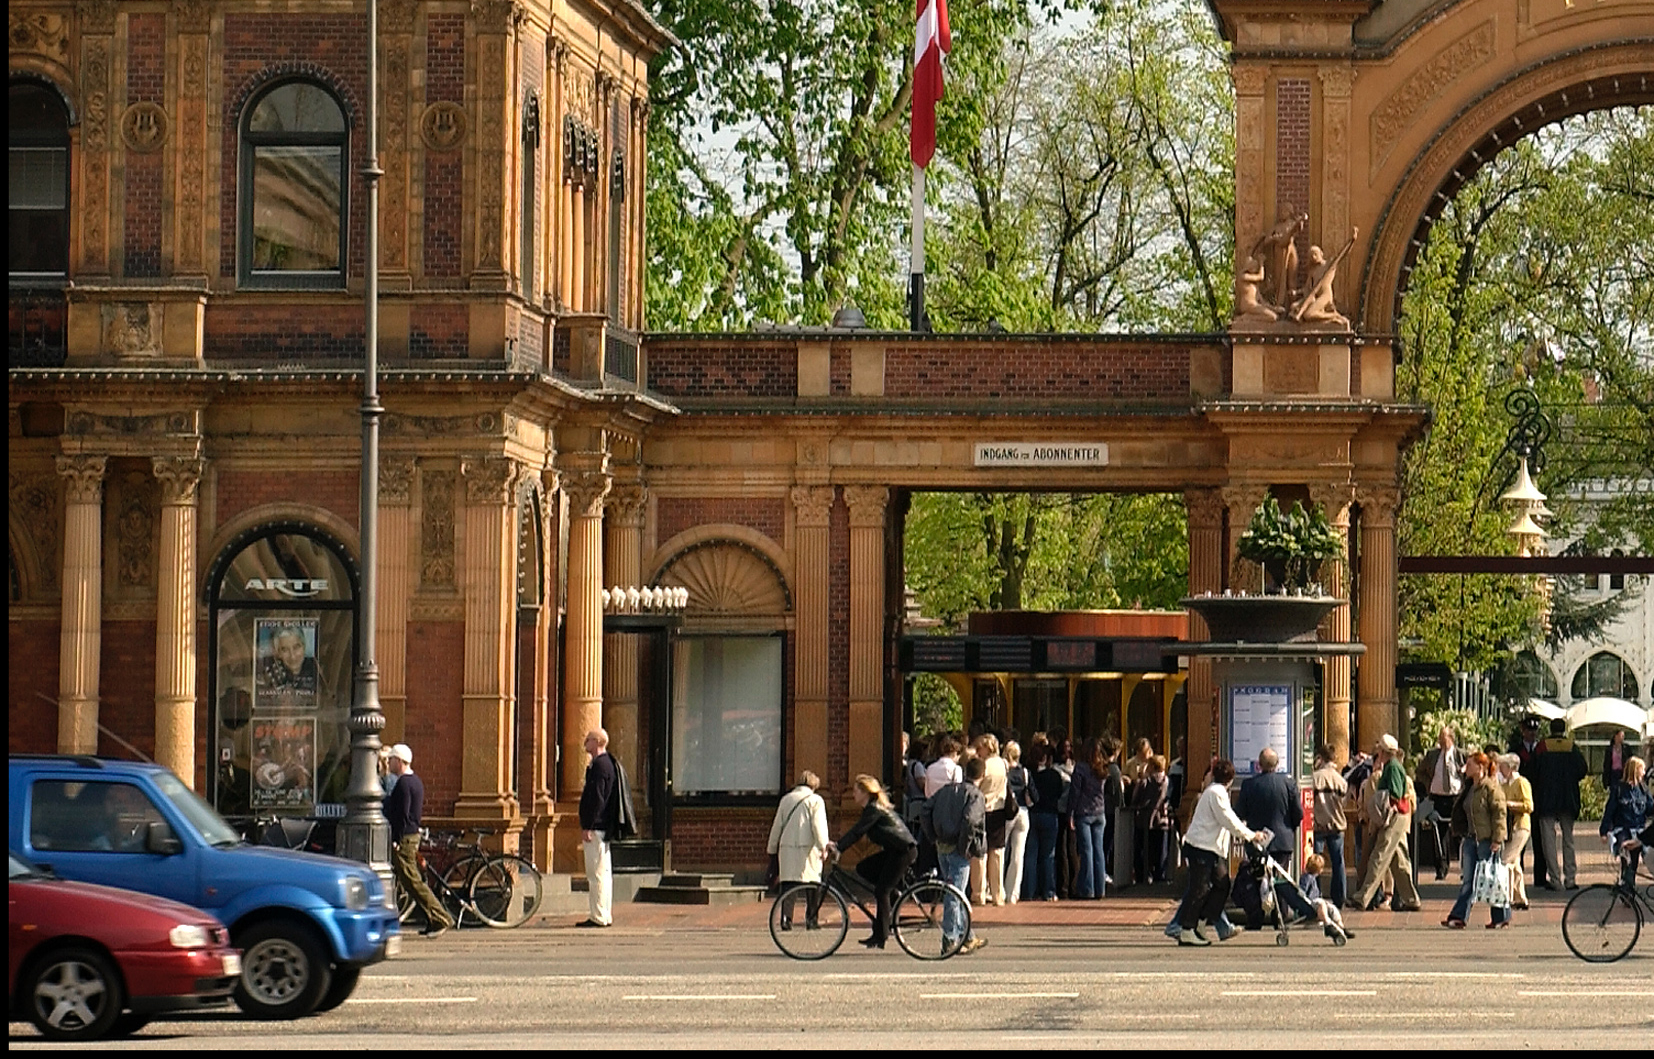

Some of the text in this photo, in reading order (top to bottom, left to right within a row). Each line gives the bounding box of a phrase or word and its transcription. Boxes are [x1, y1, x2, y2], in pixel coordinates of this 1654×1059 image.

[980, 447, 1019, 460] INDGANG
[1033, 447, 1100, 461] ABONNENTER
[245, 578, 329, 596] ARTE
